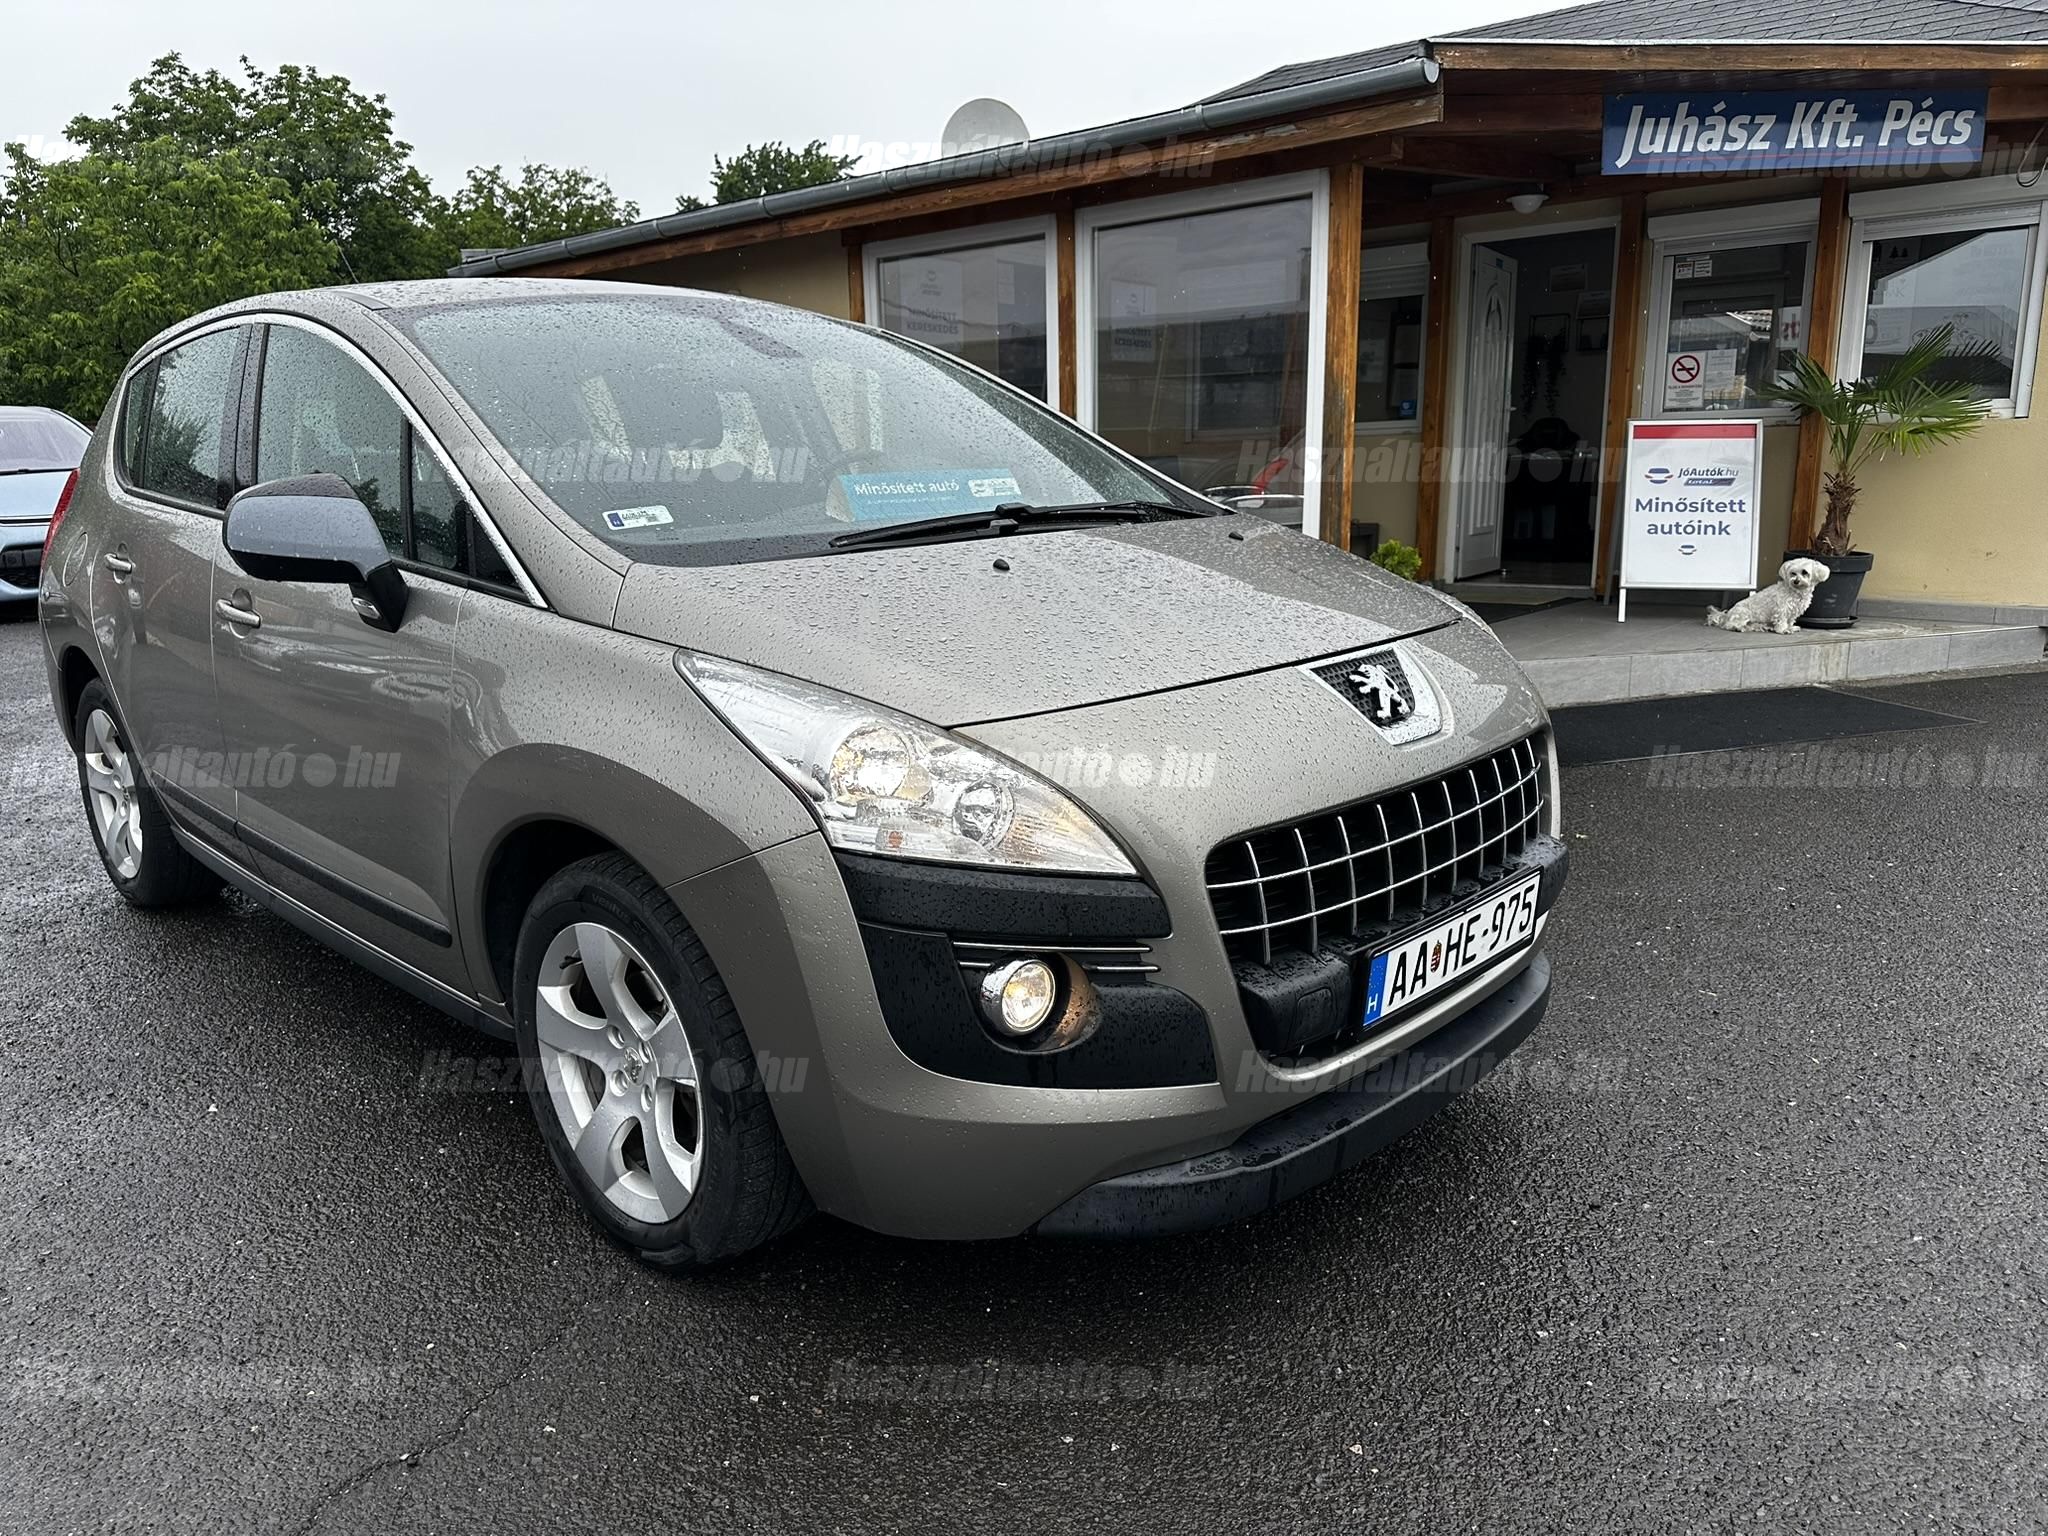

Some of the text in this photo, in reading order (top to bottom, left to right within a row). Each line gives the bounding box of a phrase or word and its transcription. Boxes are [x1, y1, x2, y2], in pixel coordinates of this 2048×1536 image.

[1615, 96, 1977, 169] Juhász Kft. Pécs
[929, 477, 960, 492] autó
[1635, 497, 1747, 513] Minősített
[1646, 520, 1731, 536] autóink
[1367, 996, 1378, 1015] H
